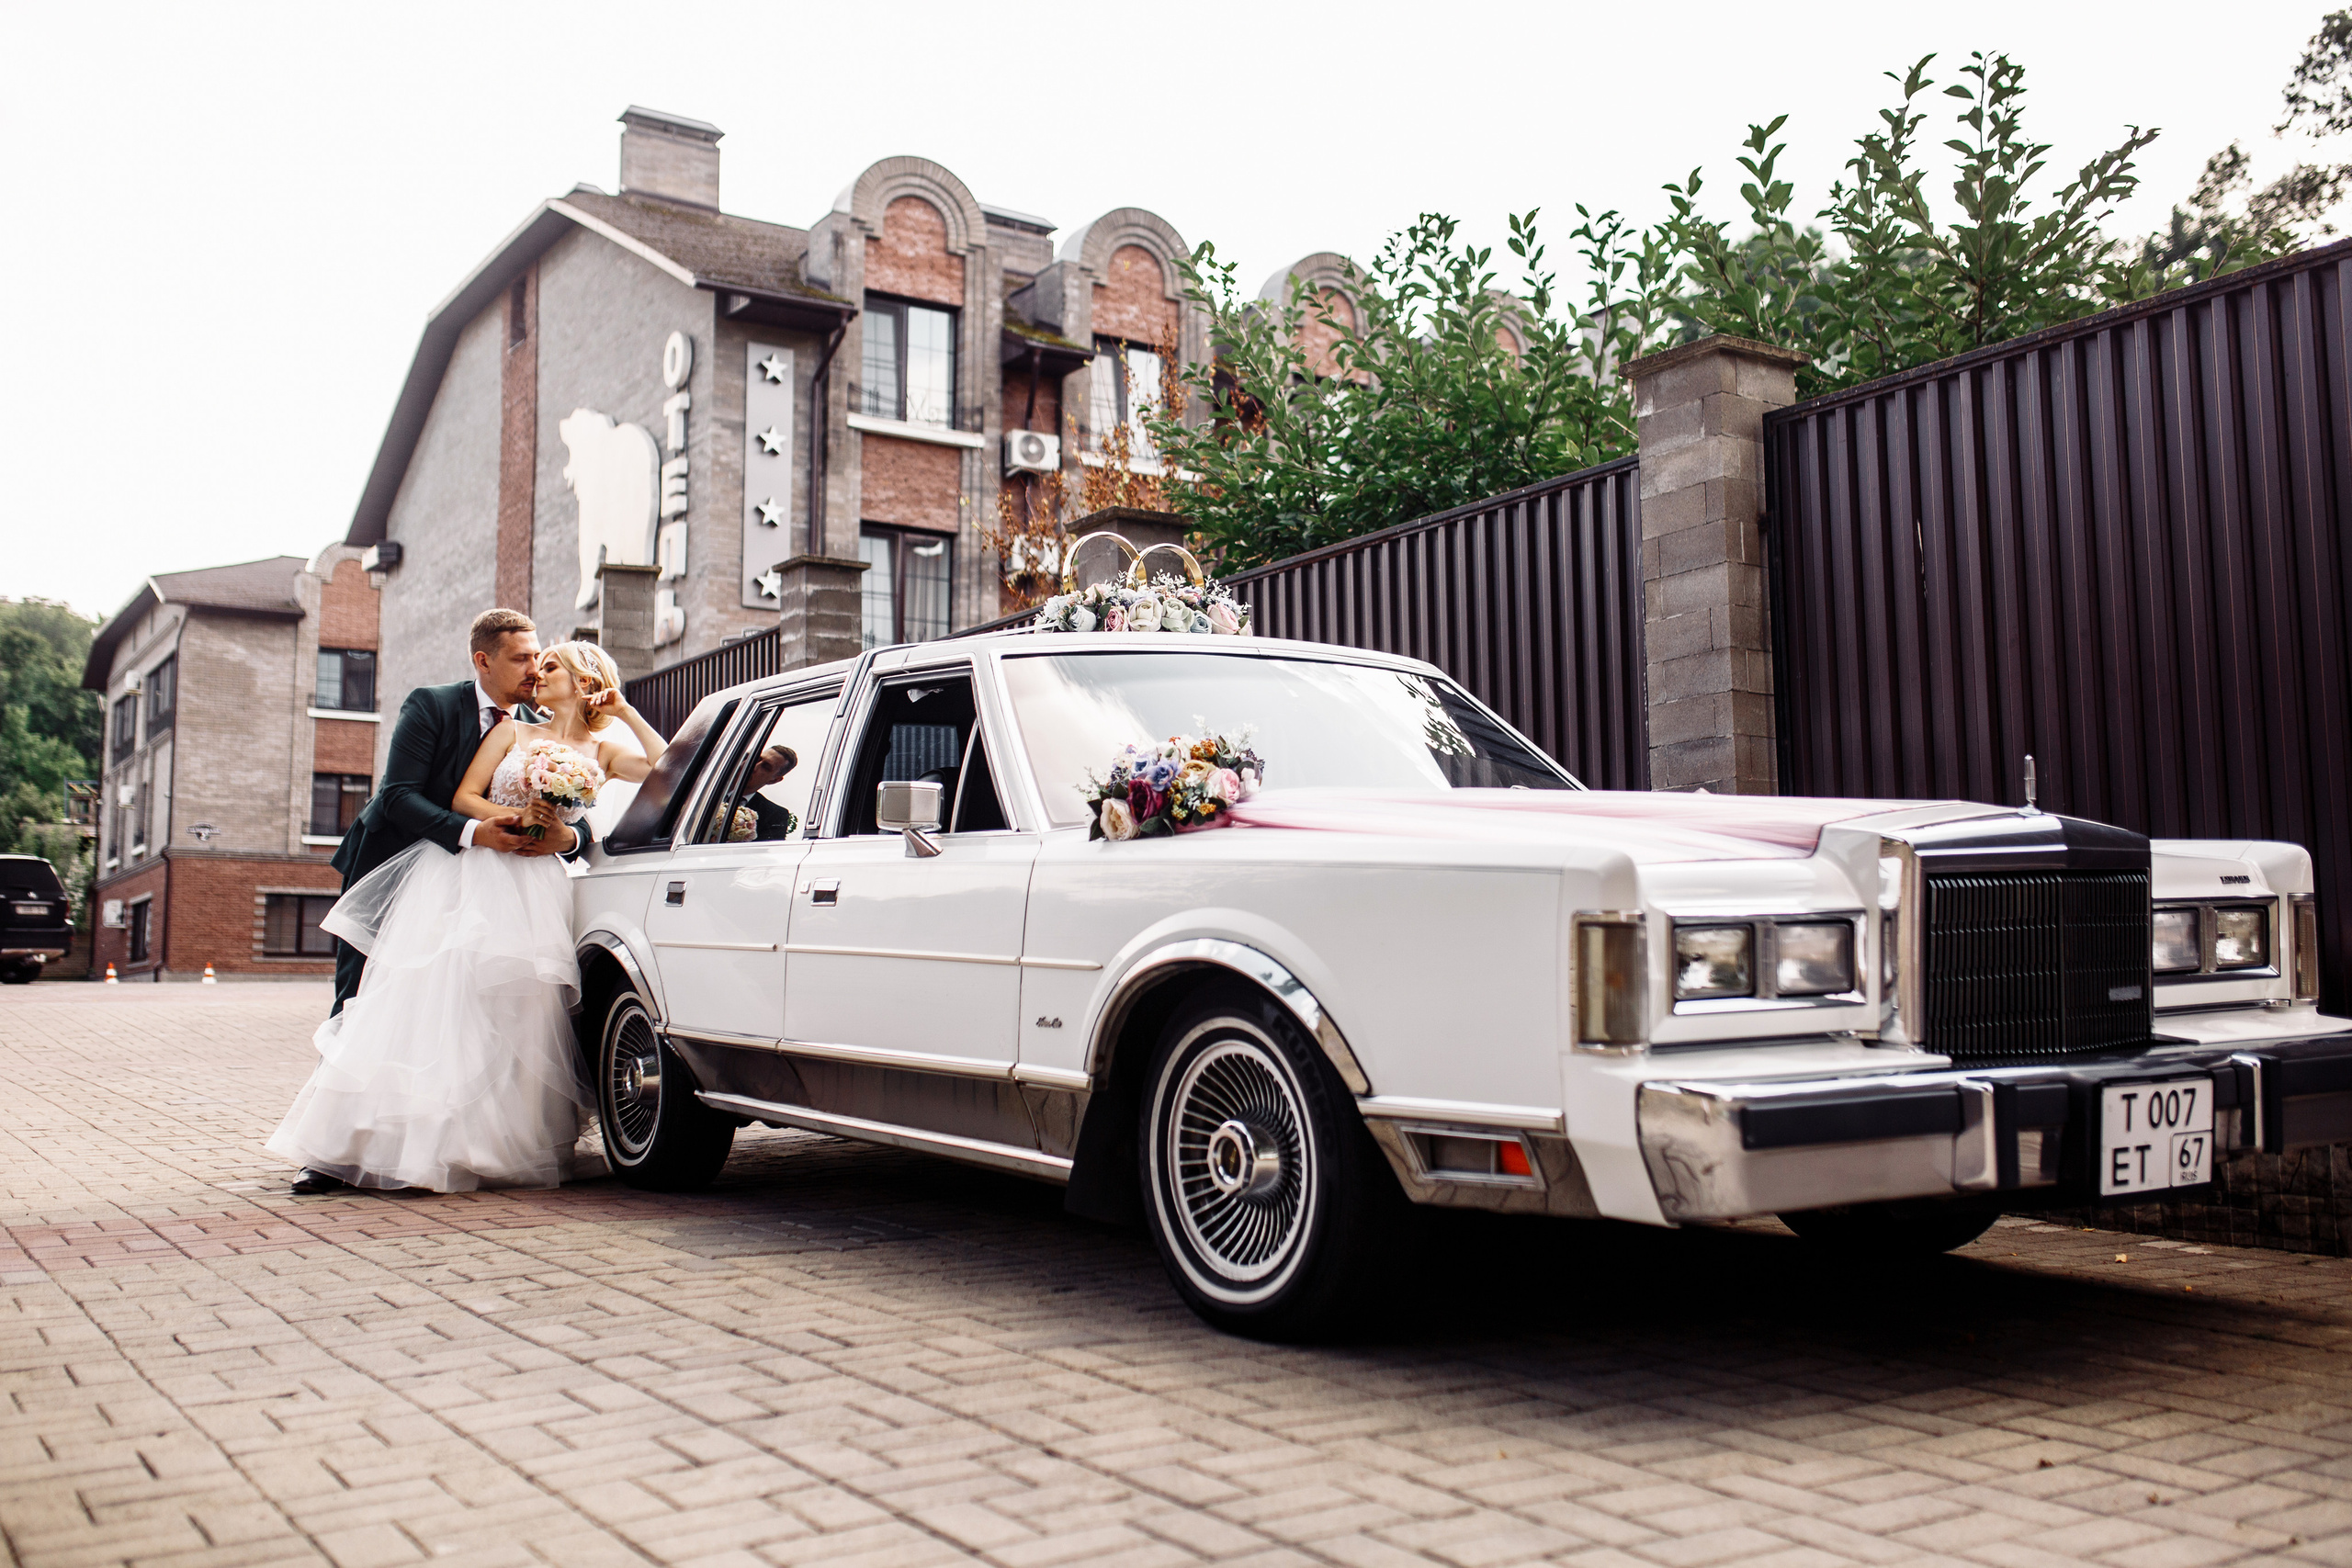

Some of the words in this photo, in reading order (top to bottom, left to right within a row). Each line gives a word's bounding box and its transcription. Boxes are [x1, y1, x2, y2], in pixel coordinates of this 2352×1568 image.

[654, 331, 693, 645] ОТЕЛЬ
[2148, 1088, 2197, 1129] 007
[2179, 1137, 2203, 1168] 67
[2180, 1169, 2199, 1182] RUS
